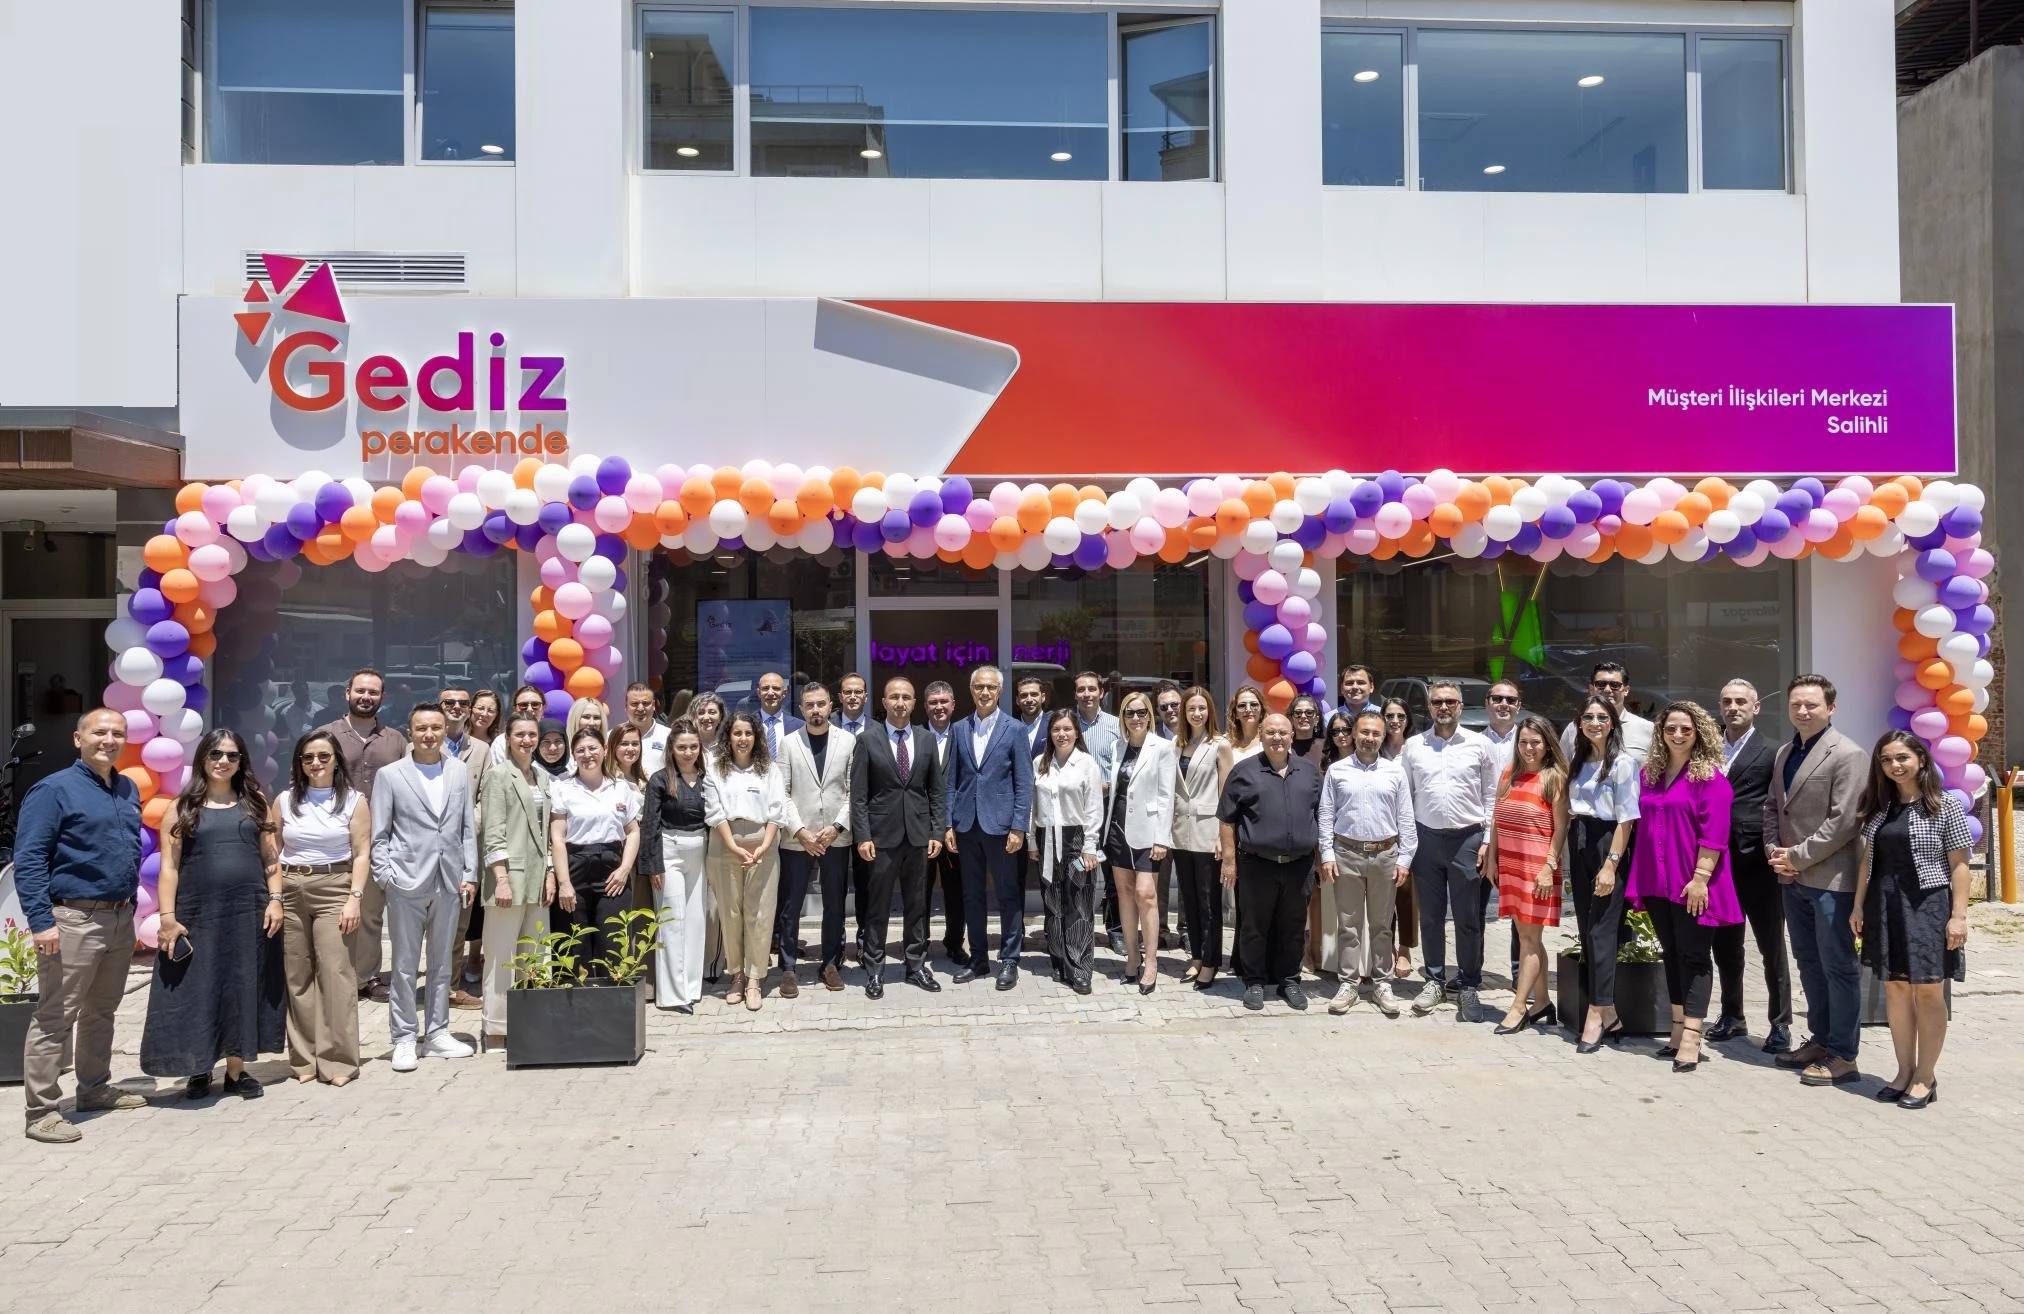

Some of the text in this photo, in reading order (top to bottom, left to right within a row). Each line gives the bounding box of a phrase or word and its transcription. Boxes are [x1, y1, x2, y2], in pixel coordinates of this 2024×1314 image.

[269, 331, 567, 412] Gediz
[1648, 384, 1888, 411] Müşteri İlişkileri Merkezi
[1827, 416, 1888, 434] Salihli
[361, 423, 569, 463] perakende
[945, 639, 991, 668] için
